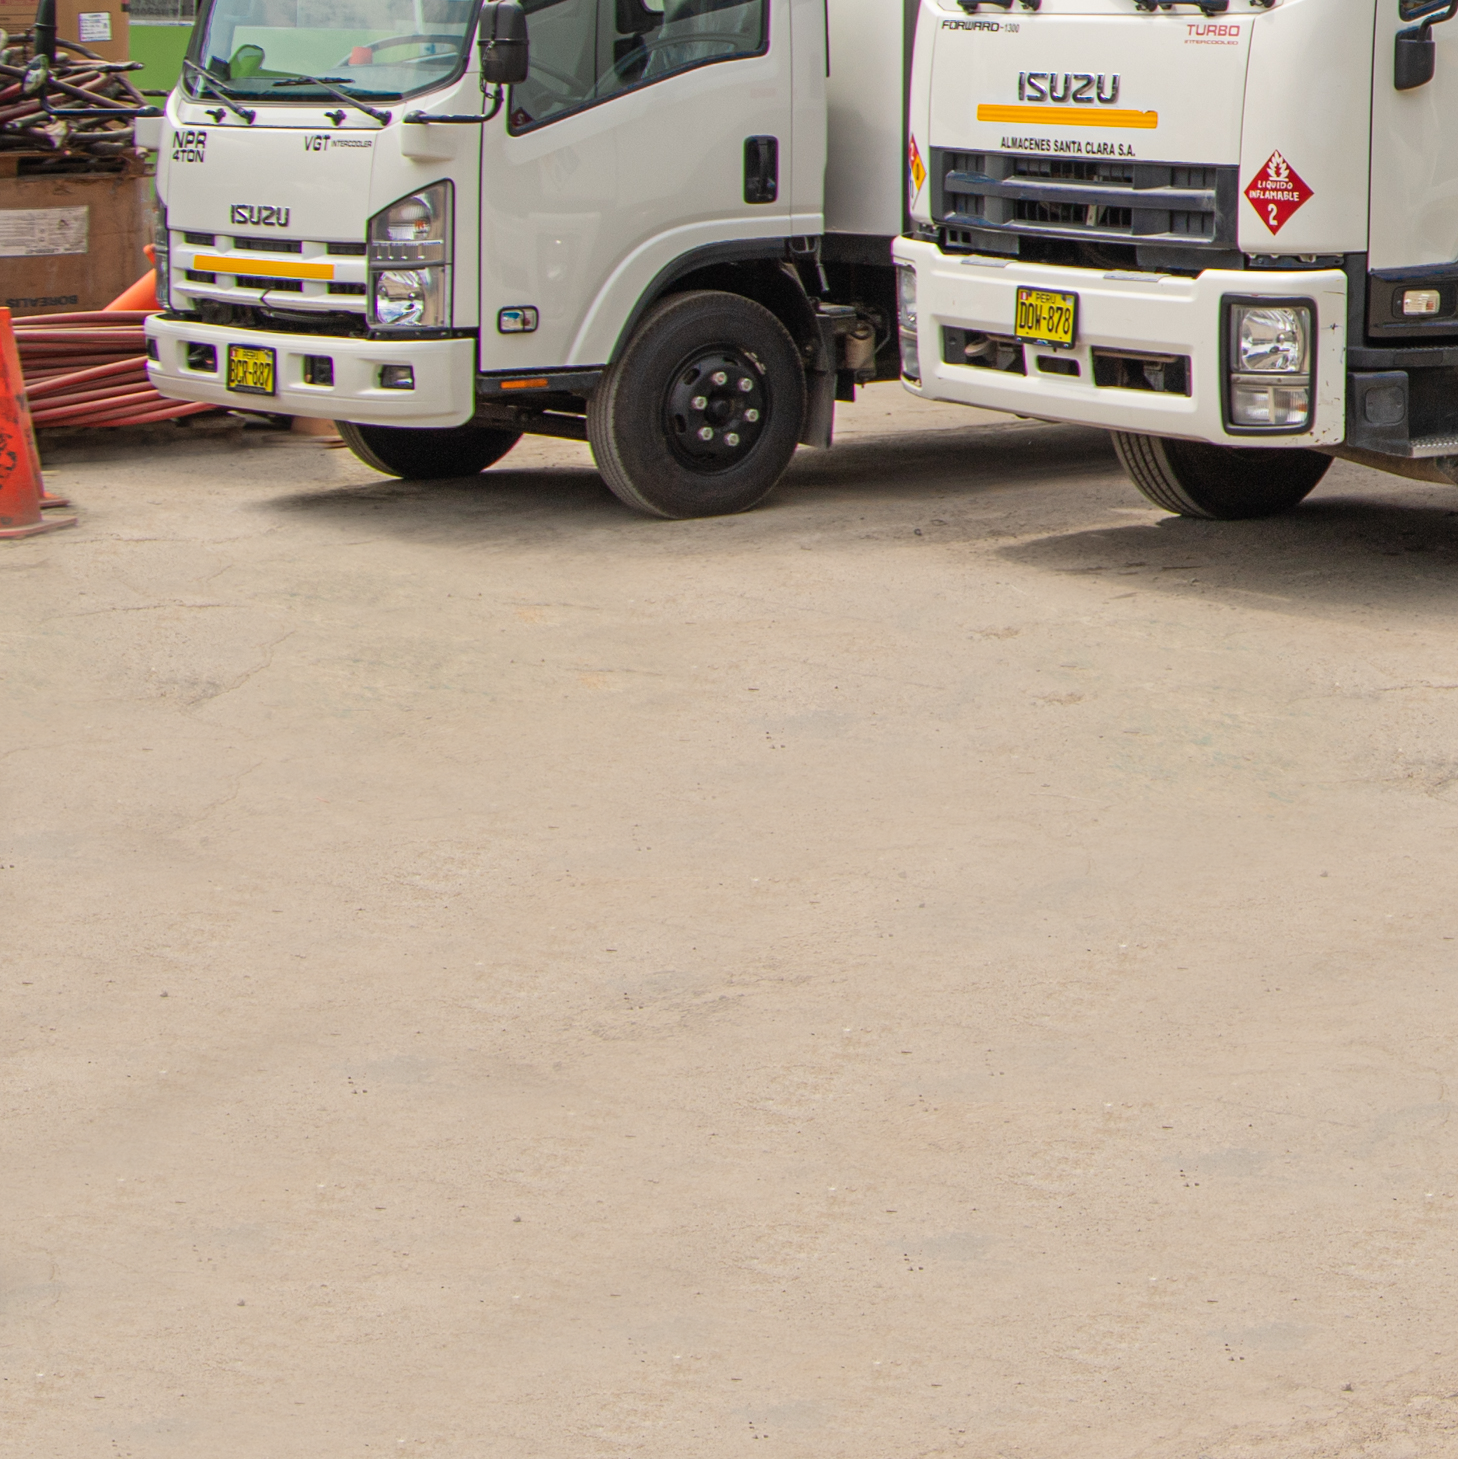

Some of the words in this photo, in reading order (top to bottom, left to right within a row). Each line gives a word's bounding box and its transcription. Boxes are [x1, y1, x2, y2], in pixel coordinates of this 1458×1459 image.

[1187, 24, 1240, 37] TURBO
[1018, 71, 1120, 104] ISUZU
[172, 131, 207, 149] NPR
[304, 134, 331, 151] VGT
[331, 139, 373, 148] INTERCOOLER
[1001, 136, 1051, 152] ALMACENES
[1053, 139, 1083, 154] SANTA
[1085, 141, 1115, 156] CLARA
[1118, 143, 1136, 157] S.A.
[172, 149, 205, 163] 4TON
[1257, 180, 1293, 190] LIQUIDO
[1249, 190, 1300, 201] INFLAMABLE
[230, 204, 290, 227] ISUZU
[1267, 203, 1278, 226] 2
[7, 294, 78, 309] BOREALIS
[1036, 292, 1056, 304] PERU
